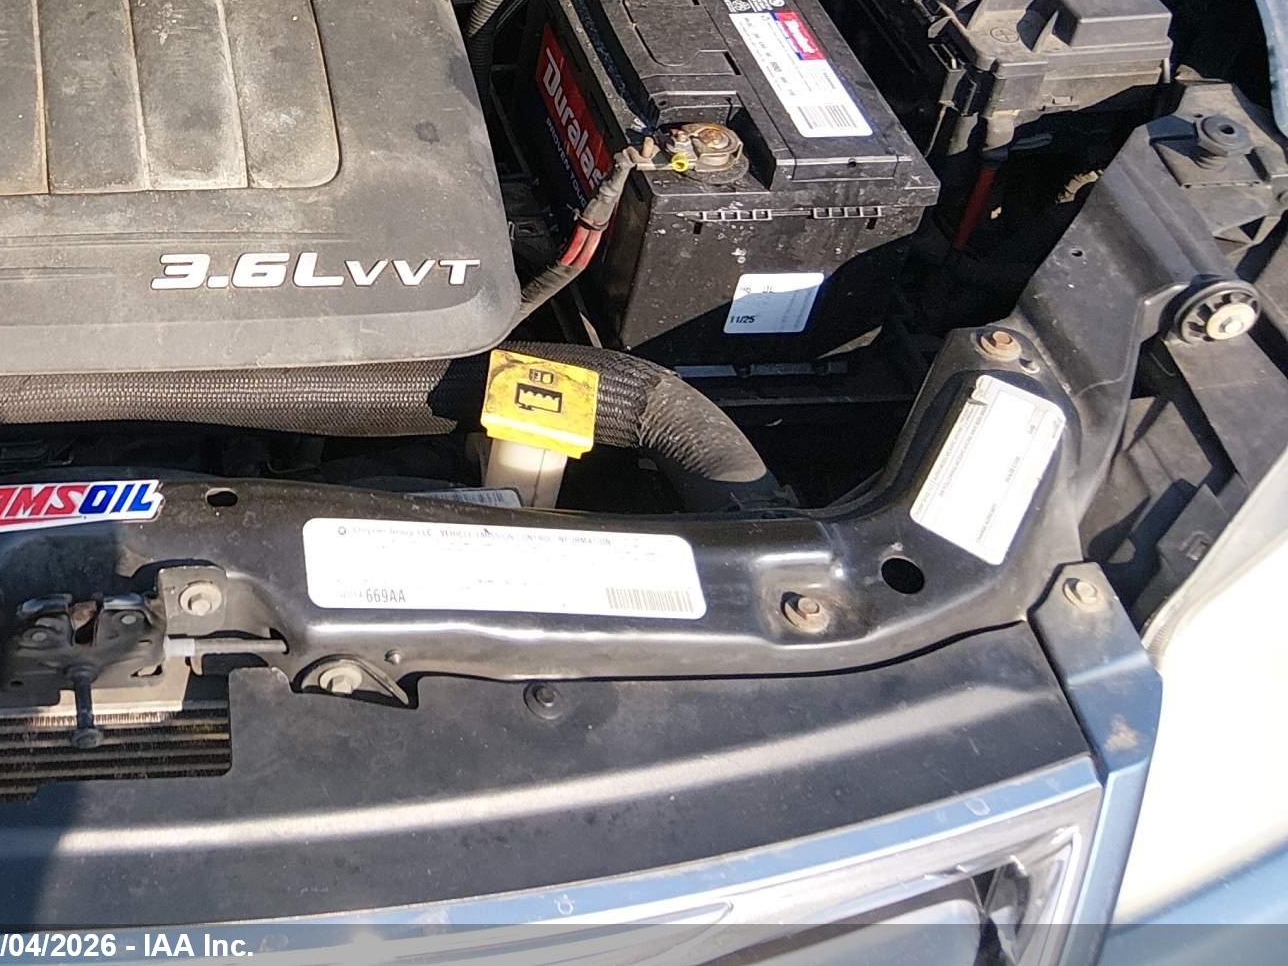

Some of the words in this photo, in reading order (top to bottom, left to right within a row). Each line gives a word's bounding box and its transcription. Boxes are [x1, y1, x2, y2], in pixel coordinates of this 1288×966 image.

[543, 46, 608, 190] Duralas
[545, 117, 571, 171] PROVEN
[567, 171, 589, 208] TOUG
[728, 314, 756, 325] 11/25
